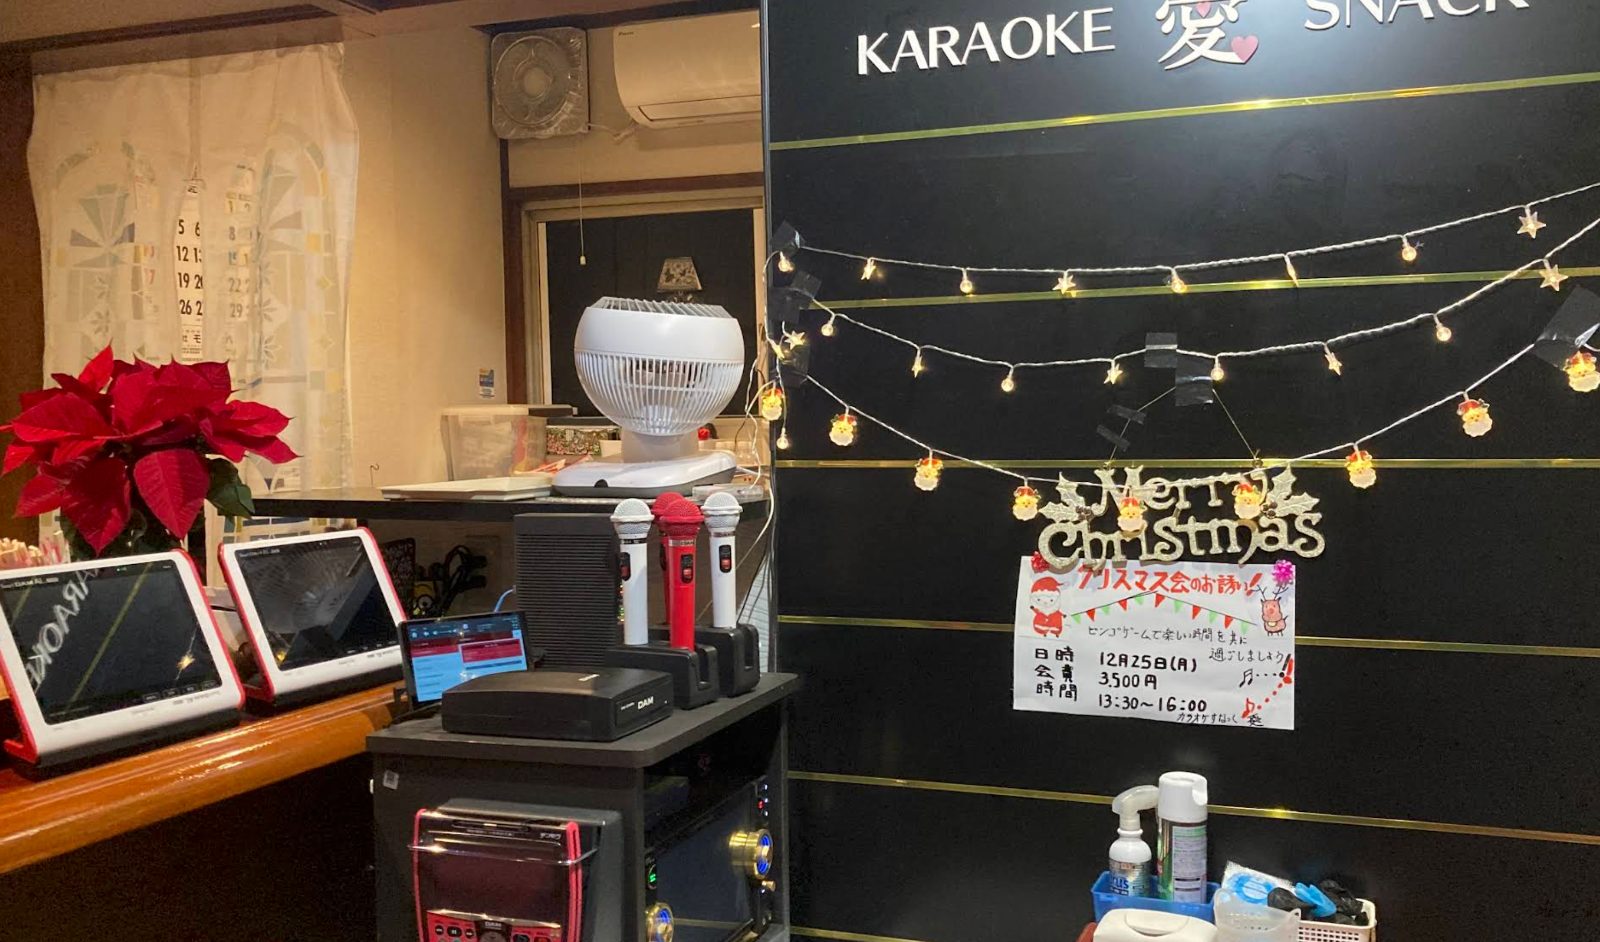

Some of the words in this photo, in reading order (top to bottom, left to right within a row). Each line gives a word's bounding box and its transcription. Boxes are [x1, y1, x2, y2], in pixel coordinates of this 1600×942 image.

[857, 7, 1115, 75] KARAOKE
[178, 218, 185, 234] 5
[194, 221, 200, 237] 6
[176, 245, 189, 261] 12
[178, 271, 190, 288] 19
[179, 299, 192, 315] 26
[1038, 512, 1325, 571] Christmas
[1035, 646, 1074, 662] 日時
[1036, 680, 1078, 702] 時間
[637, 696, 654, 710] DAM
